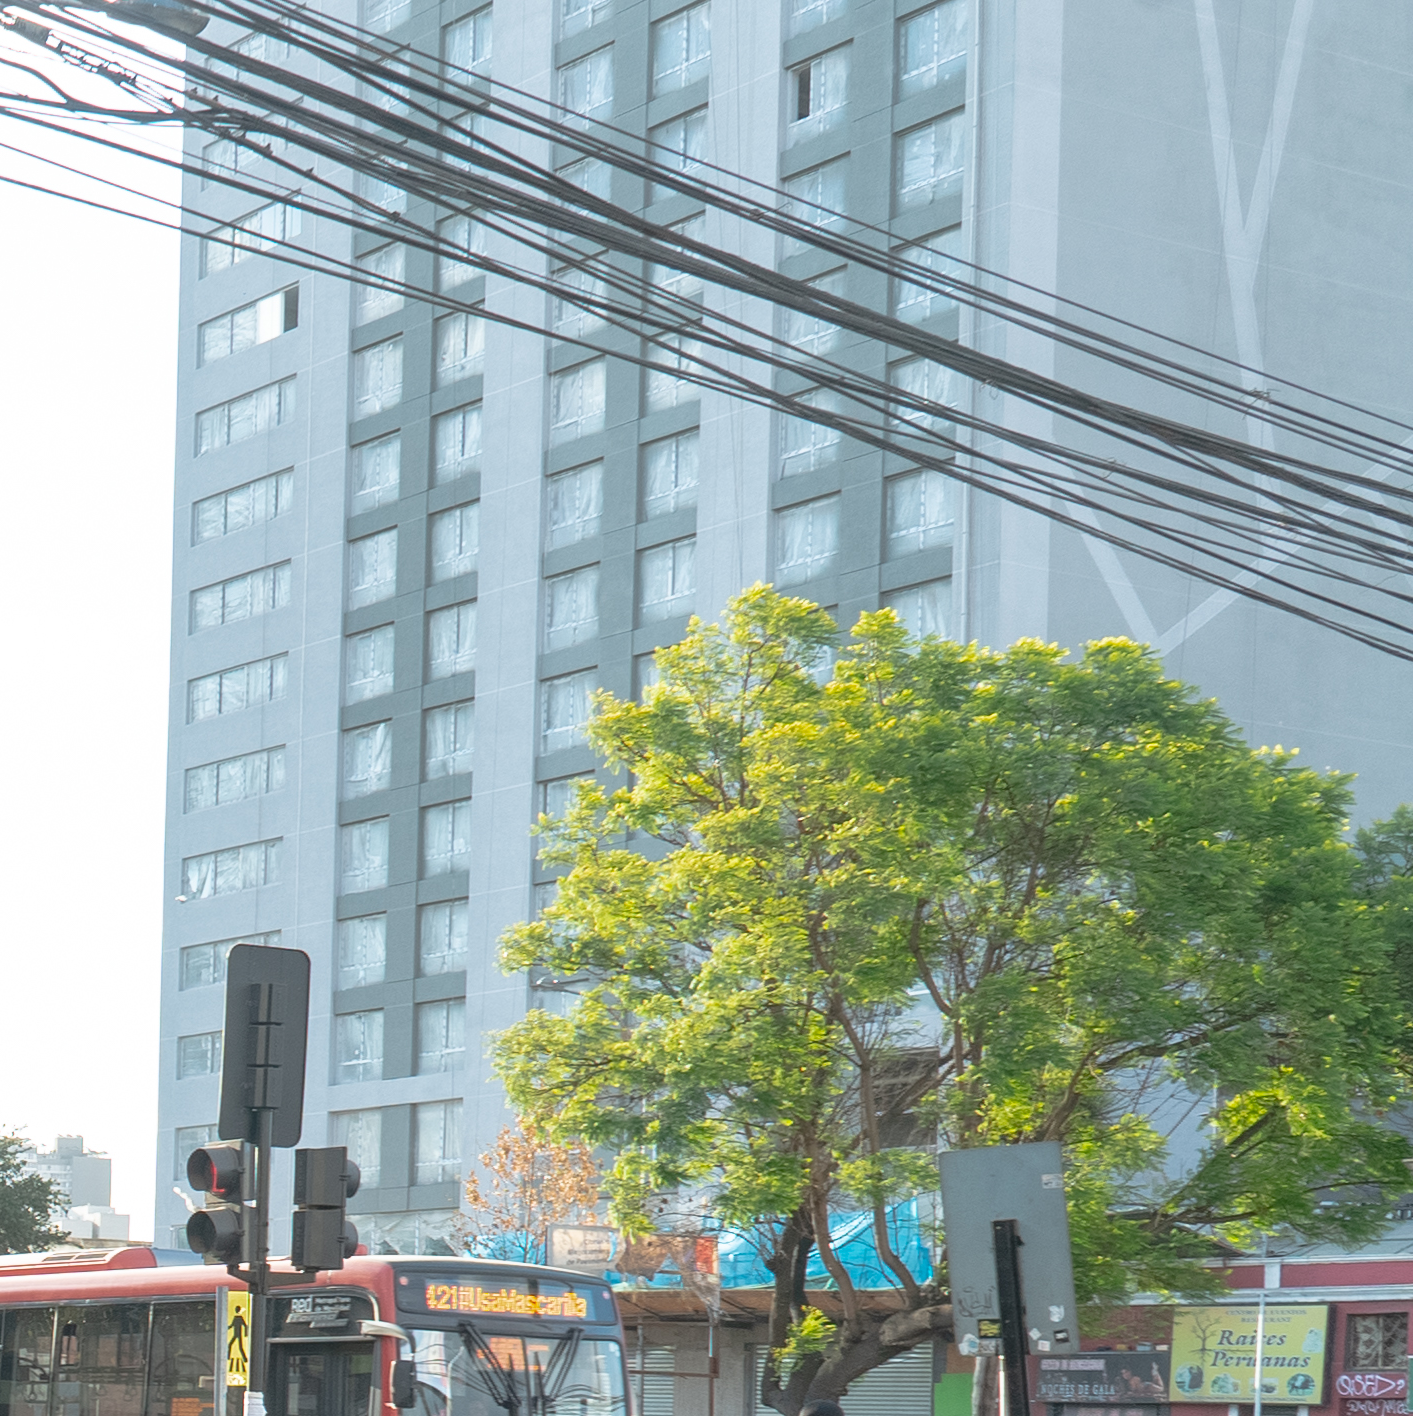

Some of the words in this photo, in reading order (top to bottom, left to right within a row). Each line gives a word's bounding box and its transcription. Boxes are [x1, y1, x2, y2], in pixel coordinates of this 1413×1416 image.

[291, 1295, 313, 1312] Red
[1040, 1383, 1075, 1396] NOCHES
[1078, 1384, 1091, 1396] DE
[1093, 1384, 1116, 1396] GALA
